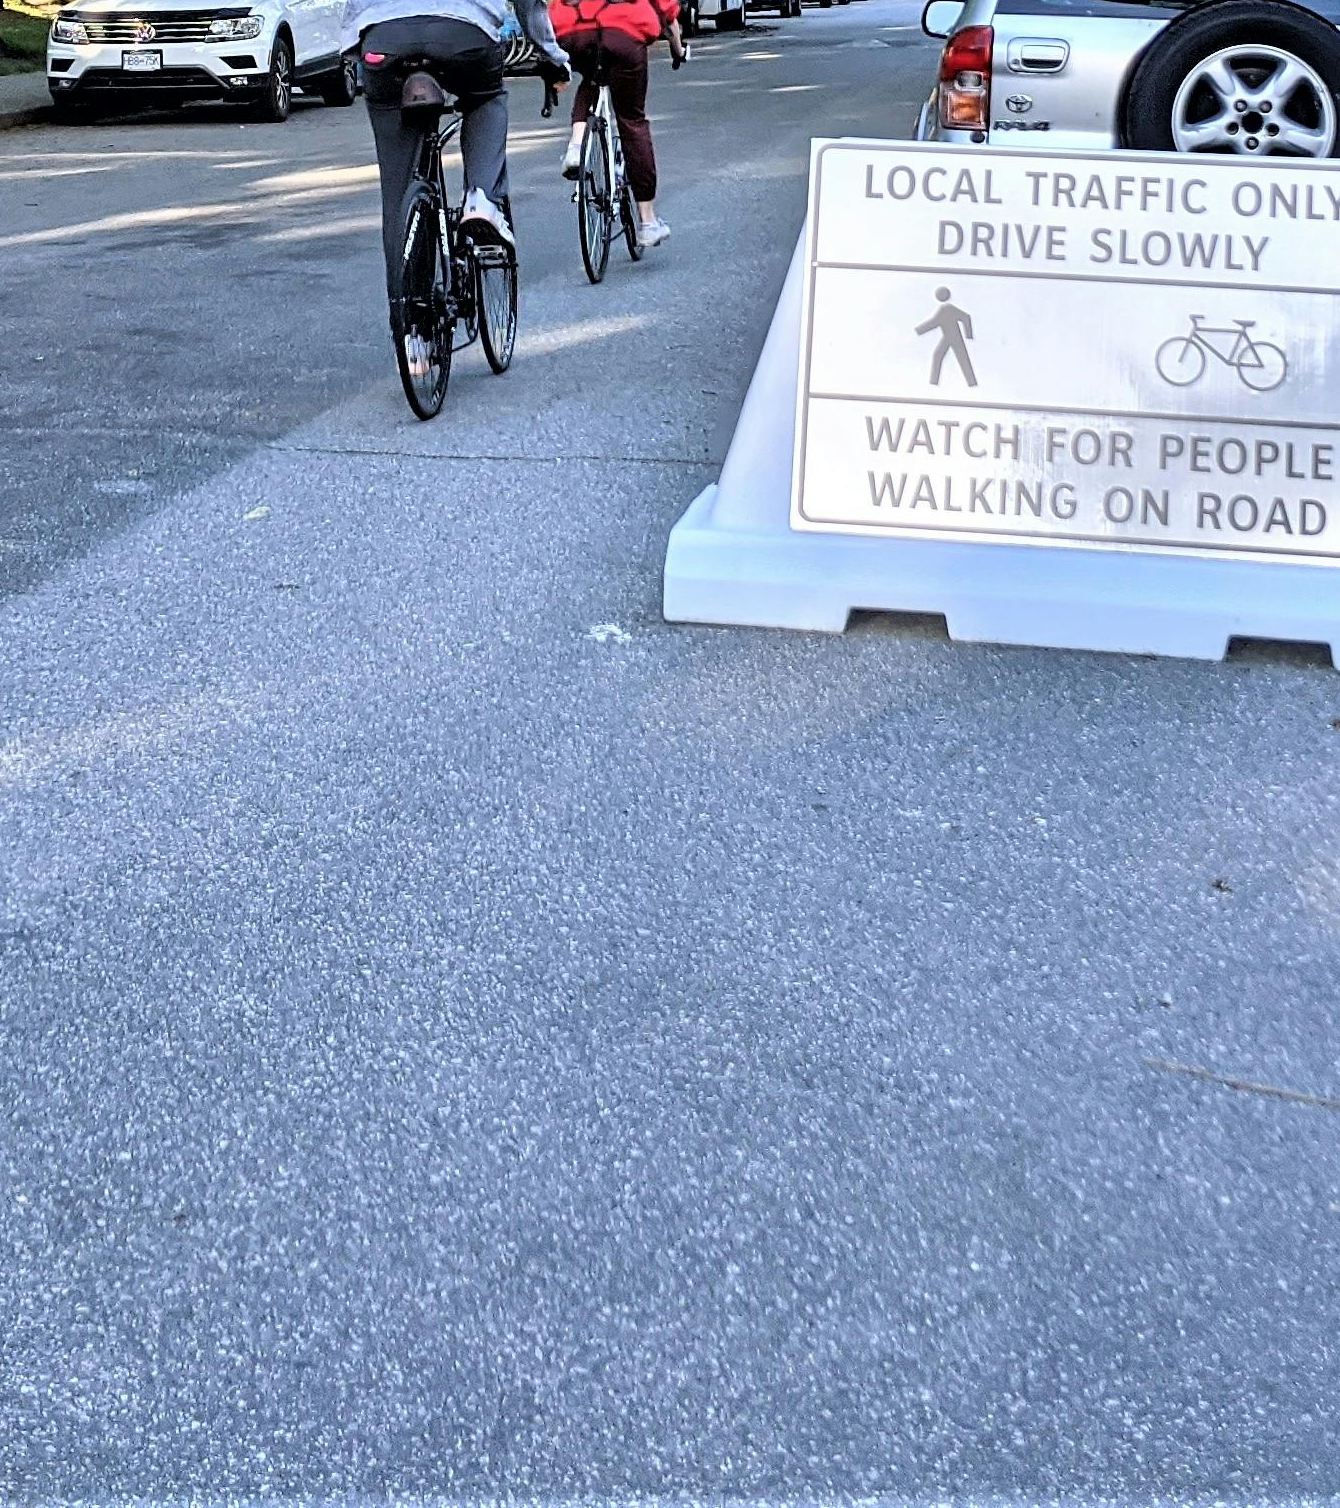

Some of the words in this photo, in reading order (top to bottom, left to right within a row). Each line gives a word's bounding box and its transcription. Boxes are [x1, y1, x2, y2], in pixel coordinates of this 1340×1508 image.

[864, 164, 1003, 205] LOCAL
[1025, 171, 1208, 214] TRAFFIC
[937, 219, 1067, 261] DRIVE
[1089, 227, 1270, 271] SLOWLY
[865, 415, 1019, 460] WATCH
[1045, 426, 1133, 468] FOR
[1159, 433, 1333, 481] PEOPLE
[867, 470, 1078, 520] WALKING
[1102, 485, 1170, 526] ON
[1196, 491, 1327, 536] ROAD
